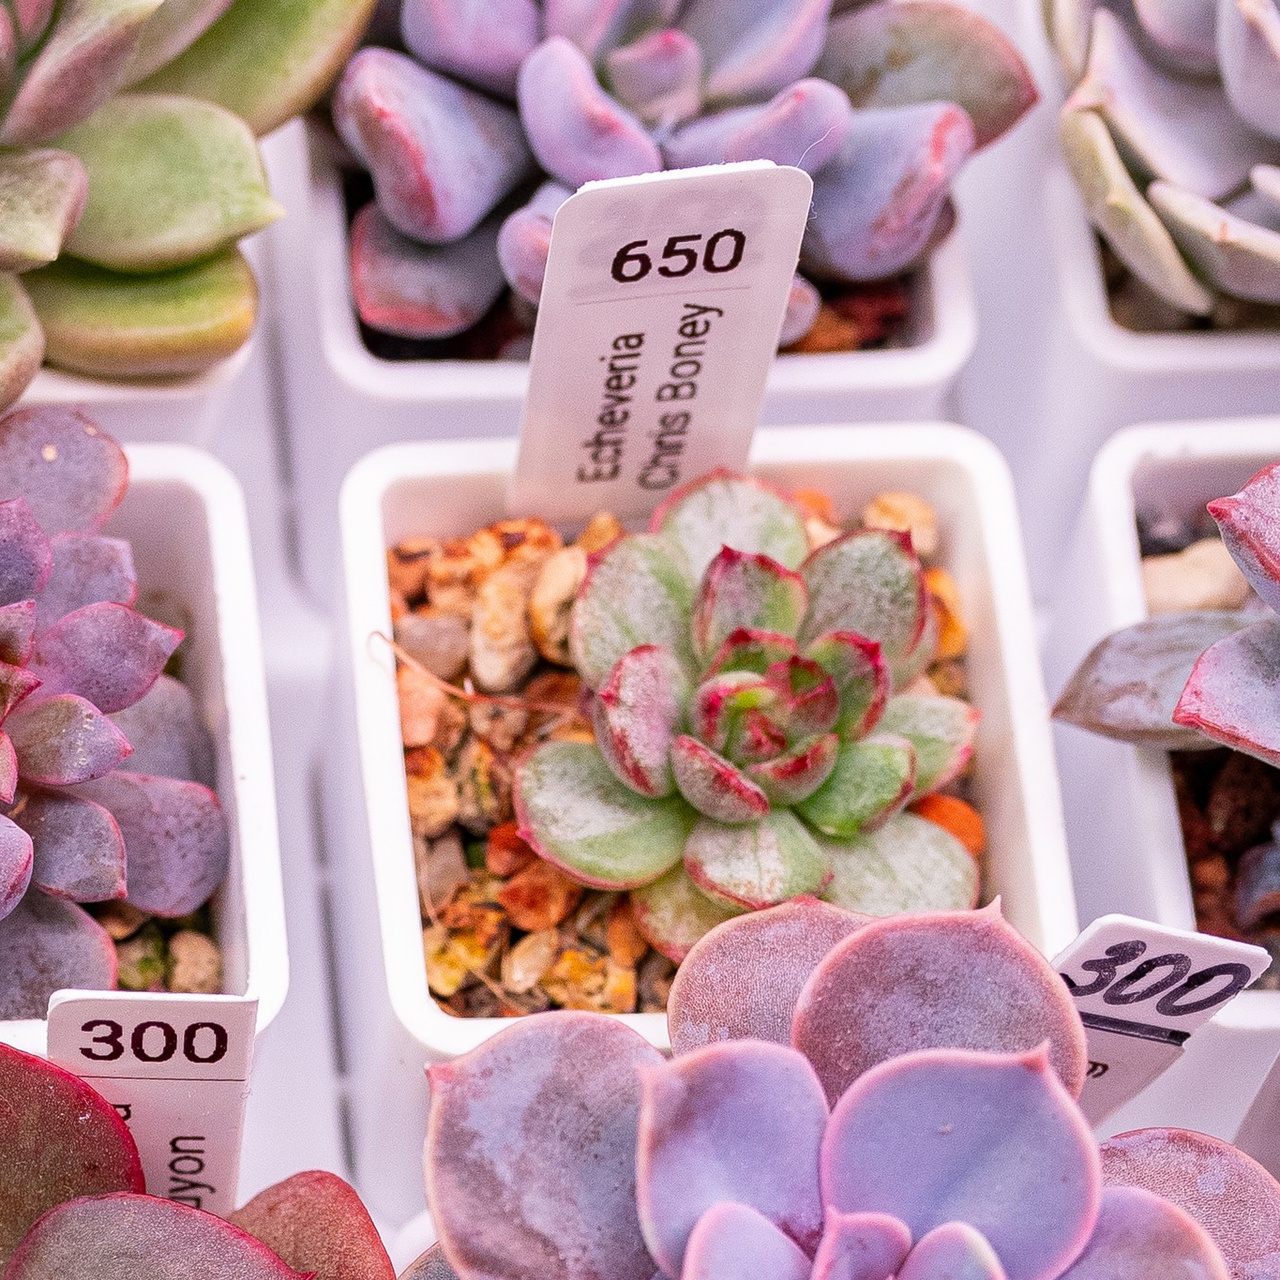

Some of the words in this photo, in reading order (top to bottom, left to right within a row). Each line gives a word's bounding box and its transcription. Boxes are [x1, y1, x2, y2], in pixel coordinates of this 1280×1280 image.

[611, 229, 746, 283] 650
[656, 303, 723, 401] Boney
[577, 332, 645, 484] Echeveria
[637, 410, 692, 491] Chris
[1059, 939, 1251, 1017] 300
[79, 1019, 228, 1063] 300
